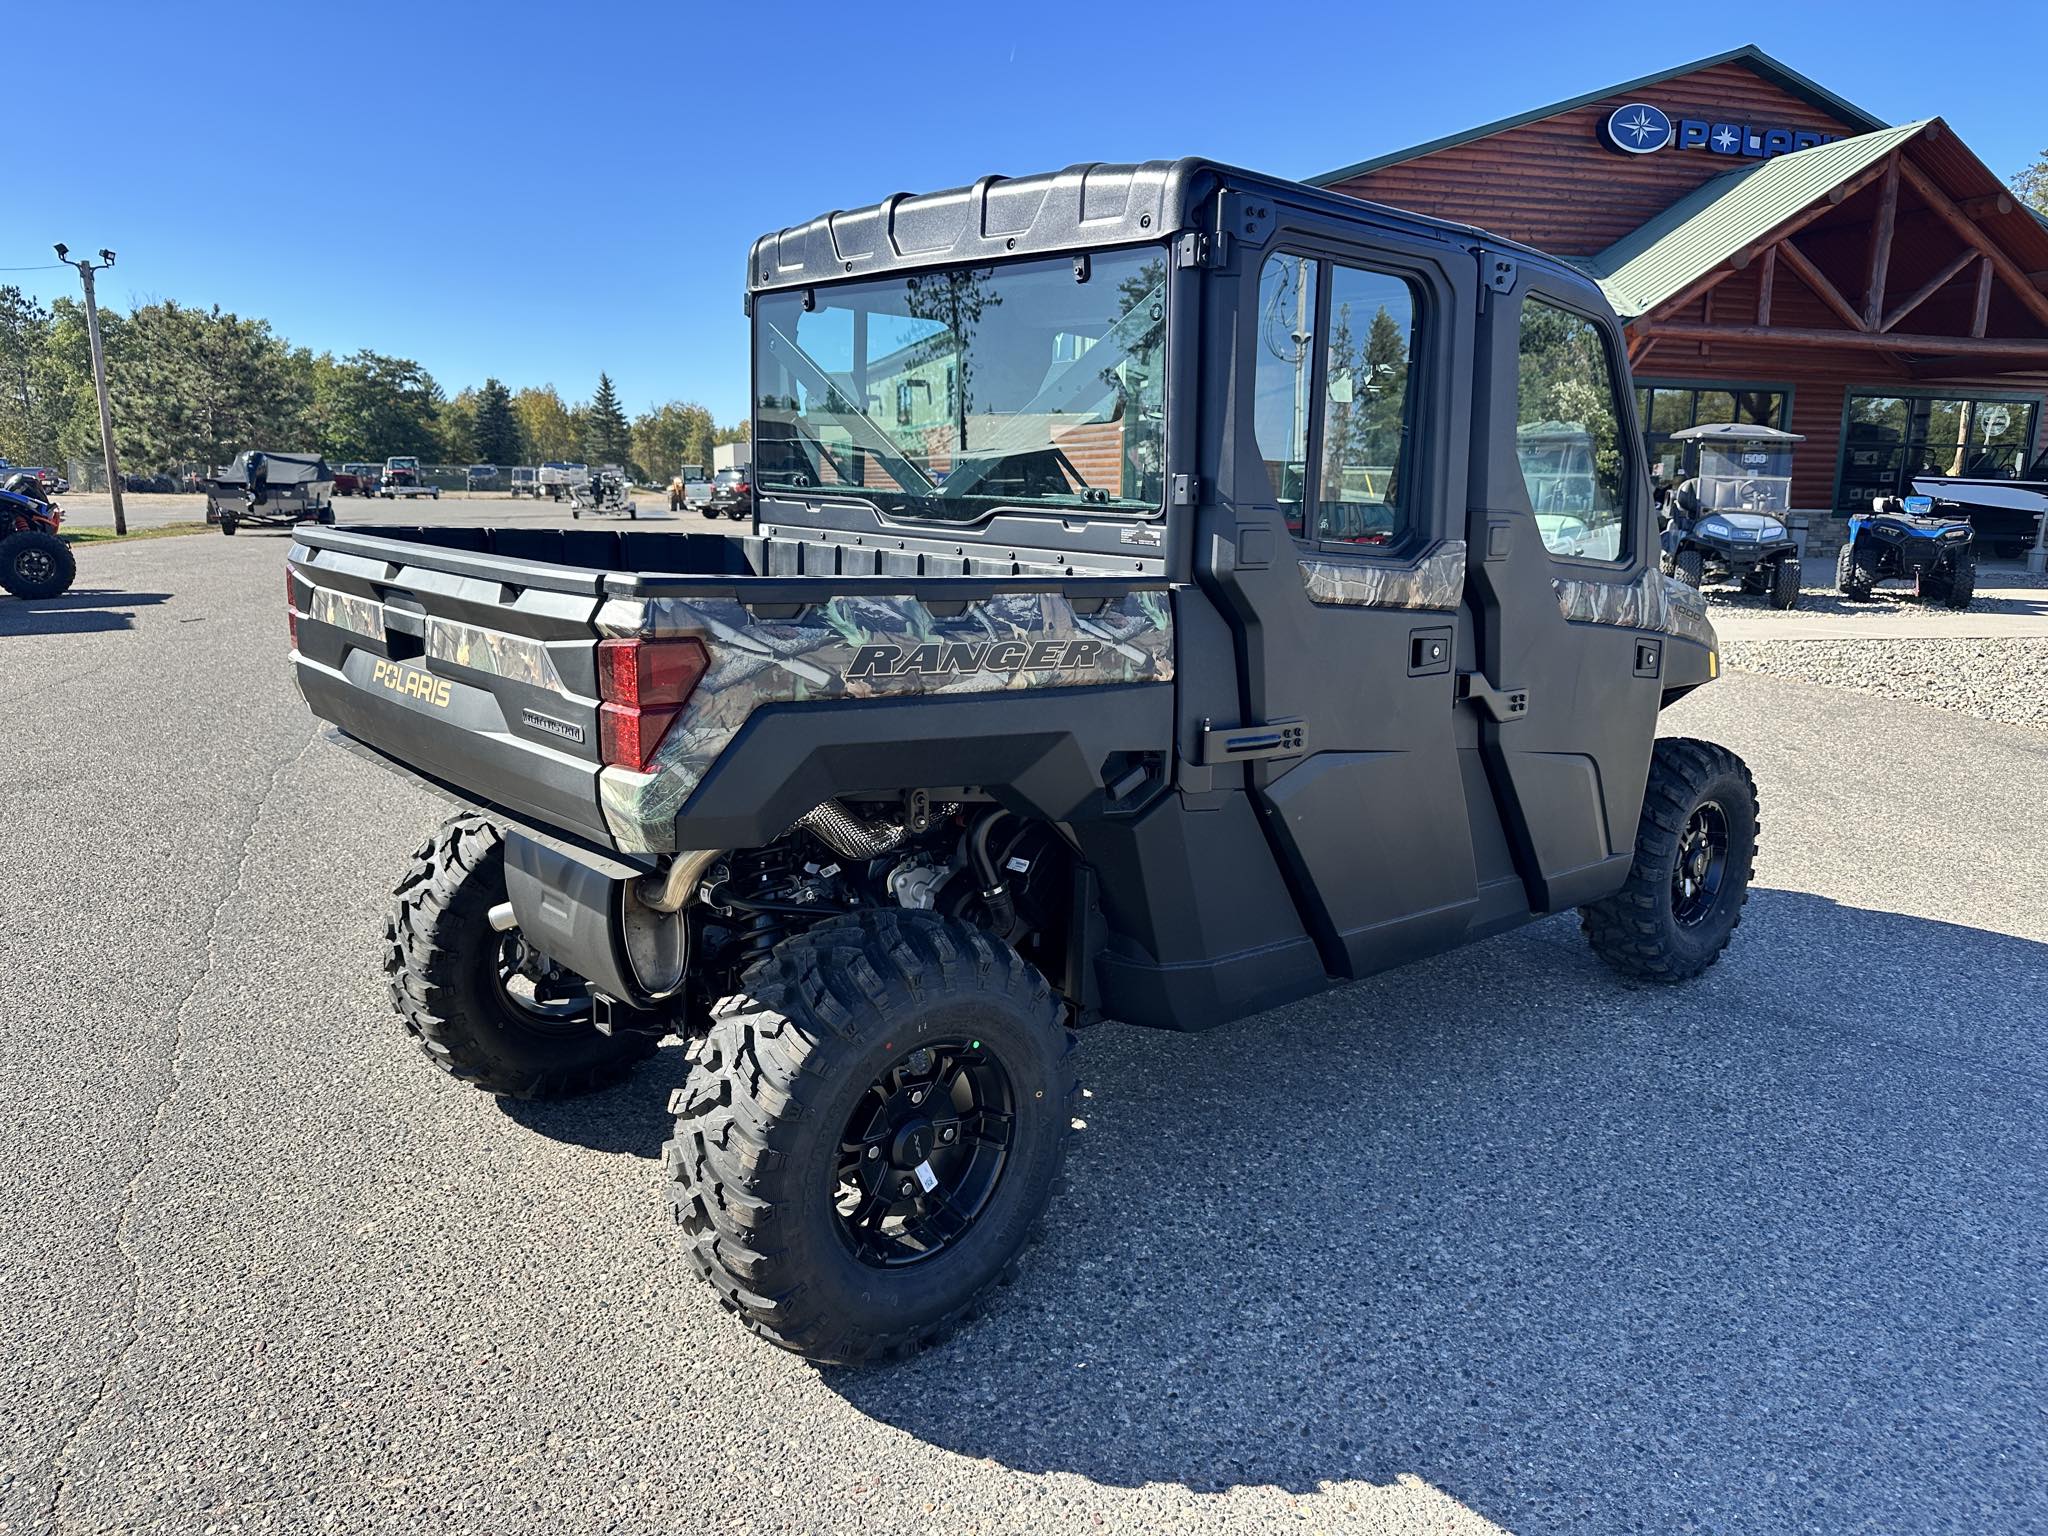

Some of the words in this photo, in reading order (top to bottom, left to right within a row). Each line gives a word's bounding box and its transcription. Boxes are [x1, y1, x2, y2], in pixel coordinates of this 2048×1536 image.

[1679, 119, 1850, 158] POLAR
[1675, 604, 1700, 620] 1000
[845, 639, 1102, 679] RANGER
[372, 659, 452, 708] POLARIS
